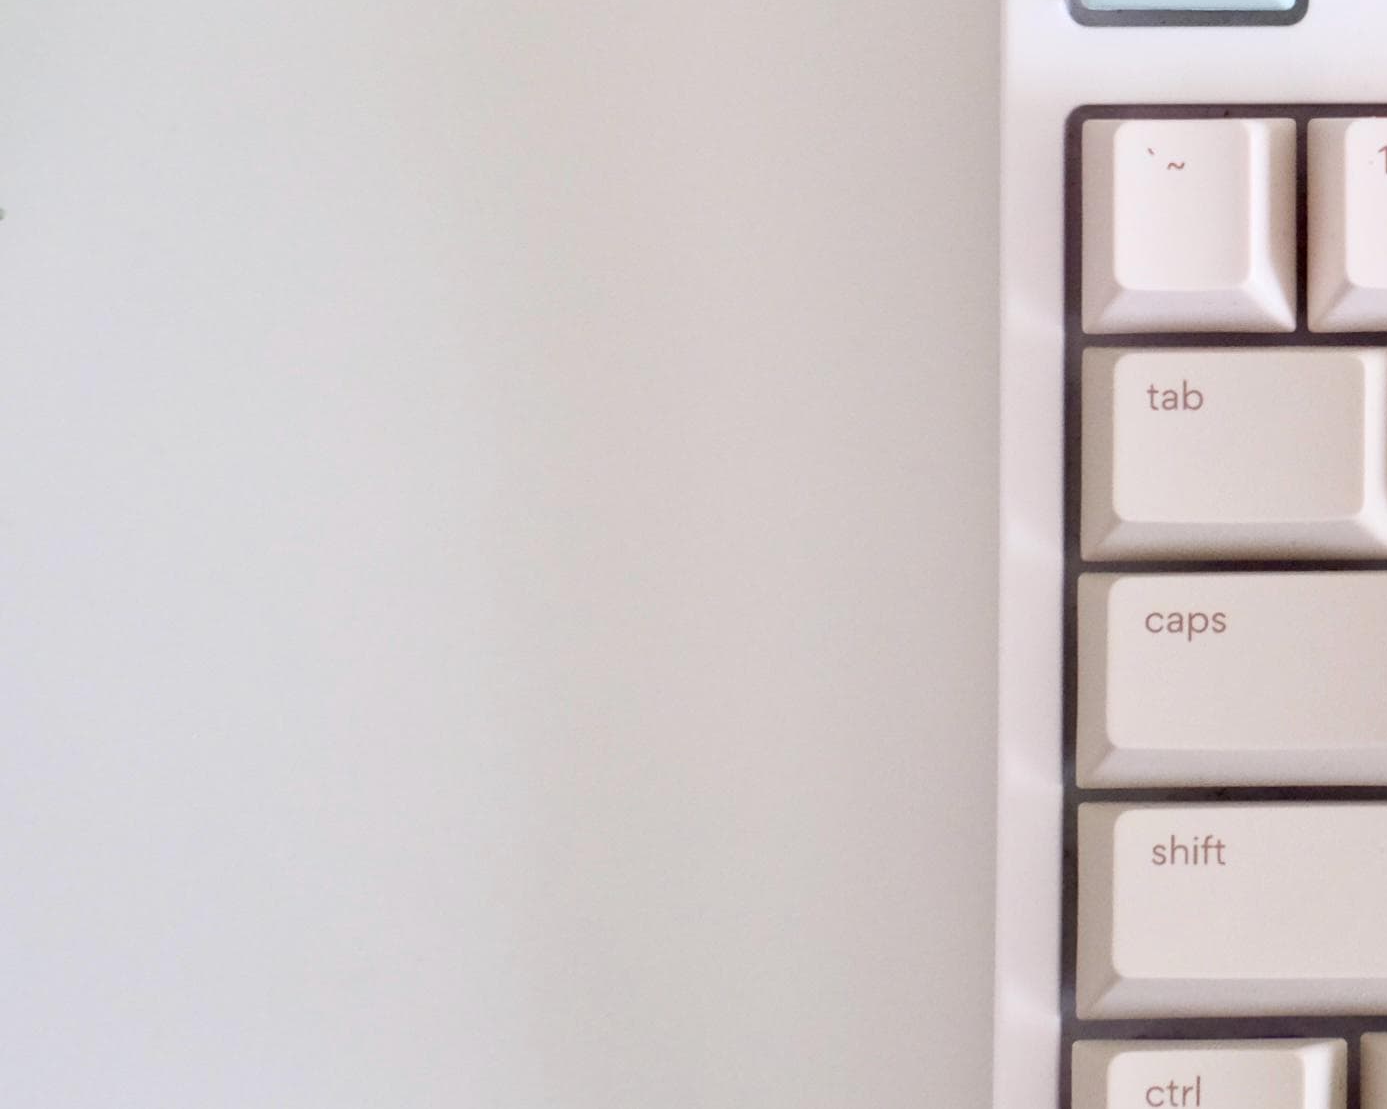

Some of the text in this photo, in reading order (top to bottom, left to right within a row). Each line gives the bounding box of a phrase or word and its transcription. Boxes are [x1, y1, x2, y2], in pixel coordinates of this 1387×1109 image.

[1146, 379, 1205, 412] tab
[1144, 611, 1227, 643] caps
[1151, 834, 1226, 866] shift
[1145, 1075, 1202, 1108] ctrl
